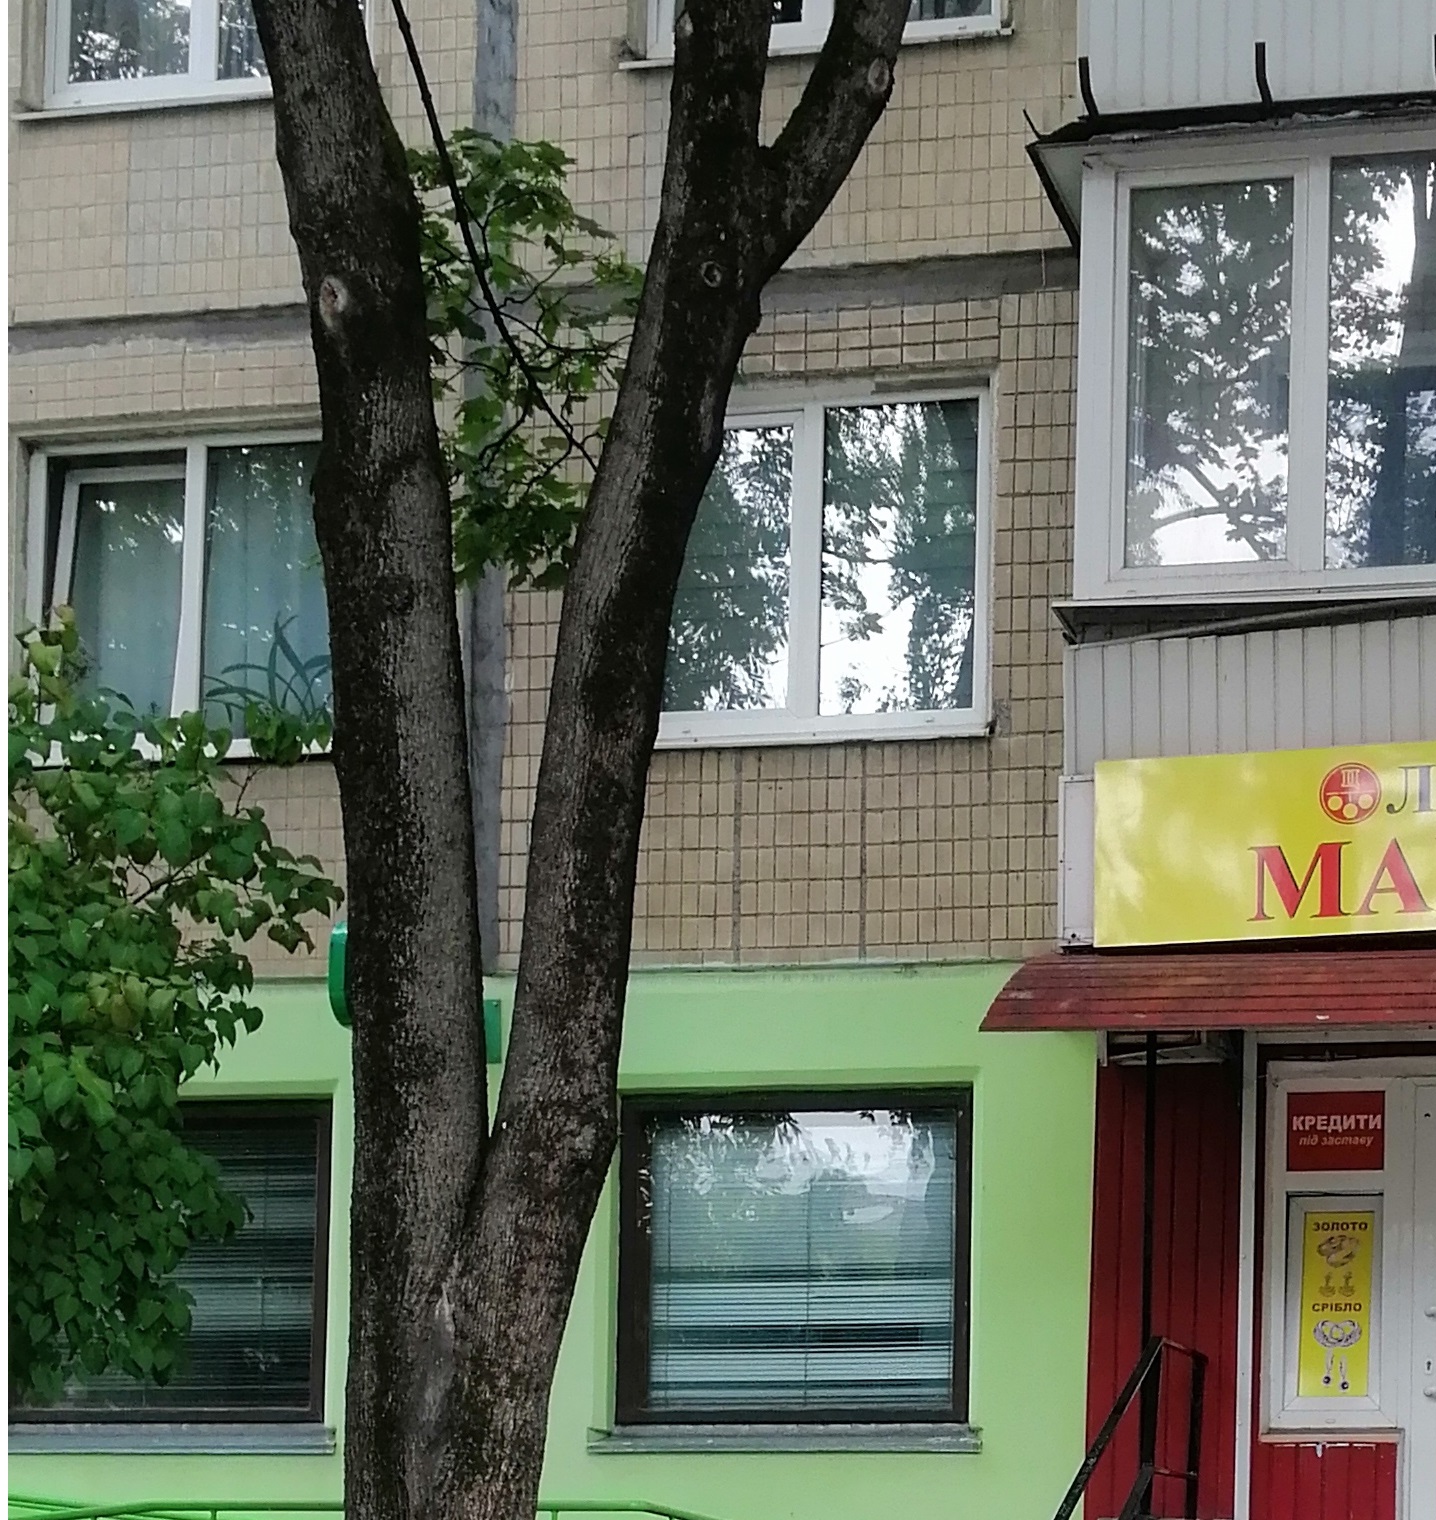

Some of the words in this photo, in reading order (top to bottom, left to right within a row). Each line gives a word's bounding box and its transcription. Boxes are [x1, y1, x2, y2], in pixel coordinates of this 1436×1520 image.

[1292, 1114, 1382, 1133] КРЕДИТИ
[1299, 1134, 1319, 1146] під
[1321, 1135, 1374, 1147] заставу
[1313, 1221, 1368, 1232] ЗОЛОТО
[1312, 1302, 1362, 1312] СРІБЛО
